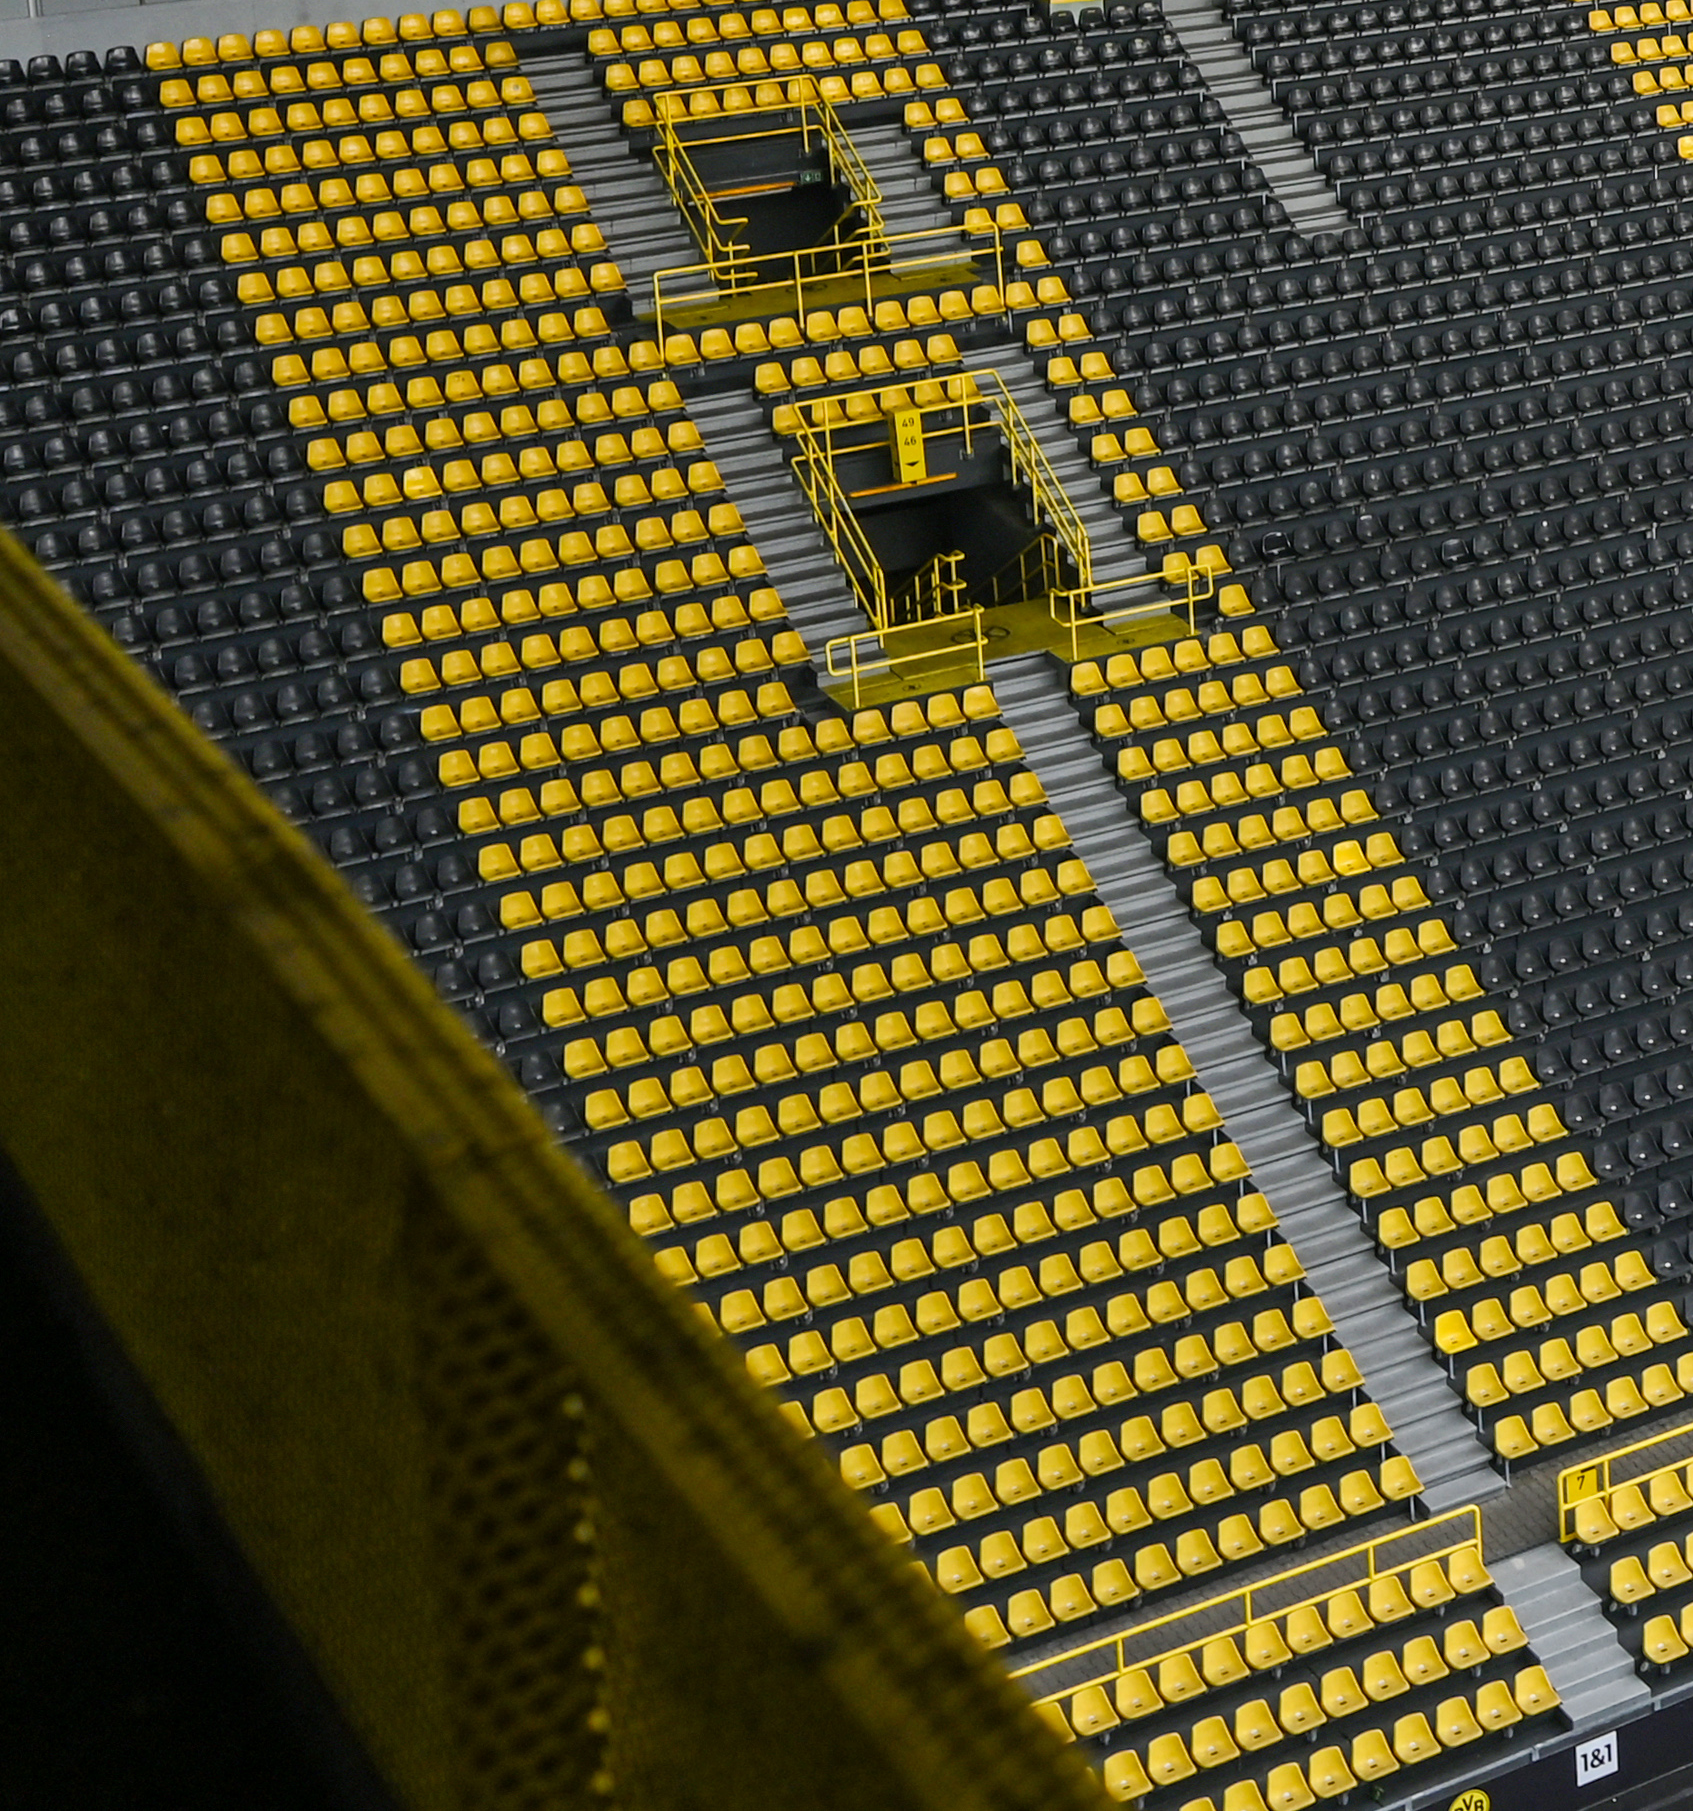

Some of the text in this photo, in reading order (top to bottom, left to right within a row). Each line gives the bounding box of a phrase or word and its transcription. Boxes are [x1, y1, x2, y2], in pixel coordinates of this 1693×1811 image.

[902, 417, 915, 428] 49
[904, 436, 917, 447] 46
[1577, 1475, 1585, 1490] 7
[1581, 1744, 1613, 1772] 1&1
[1454, 1795, 1485, 1811] VB
